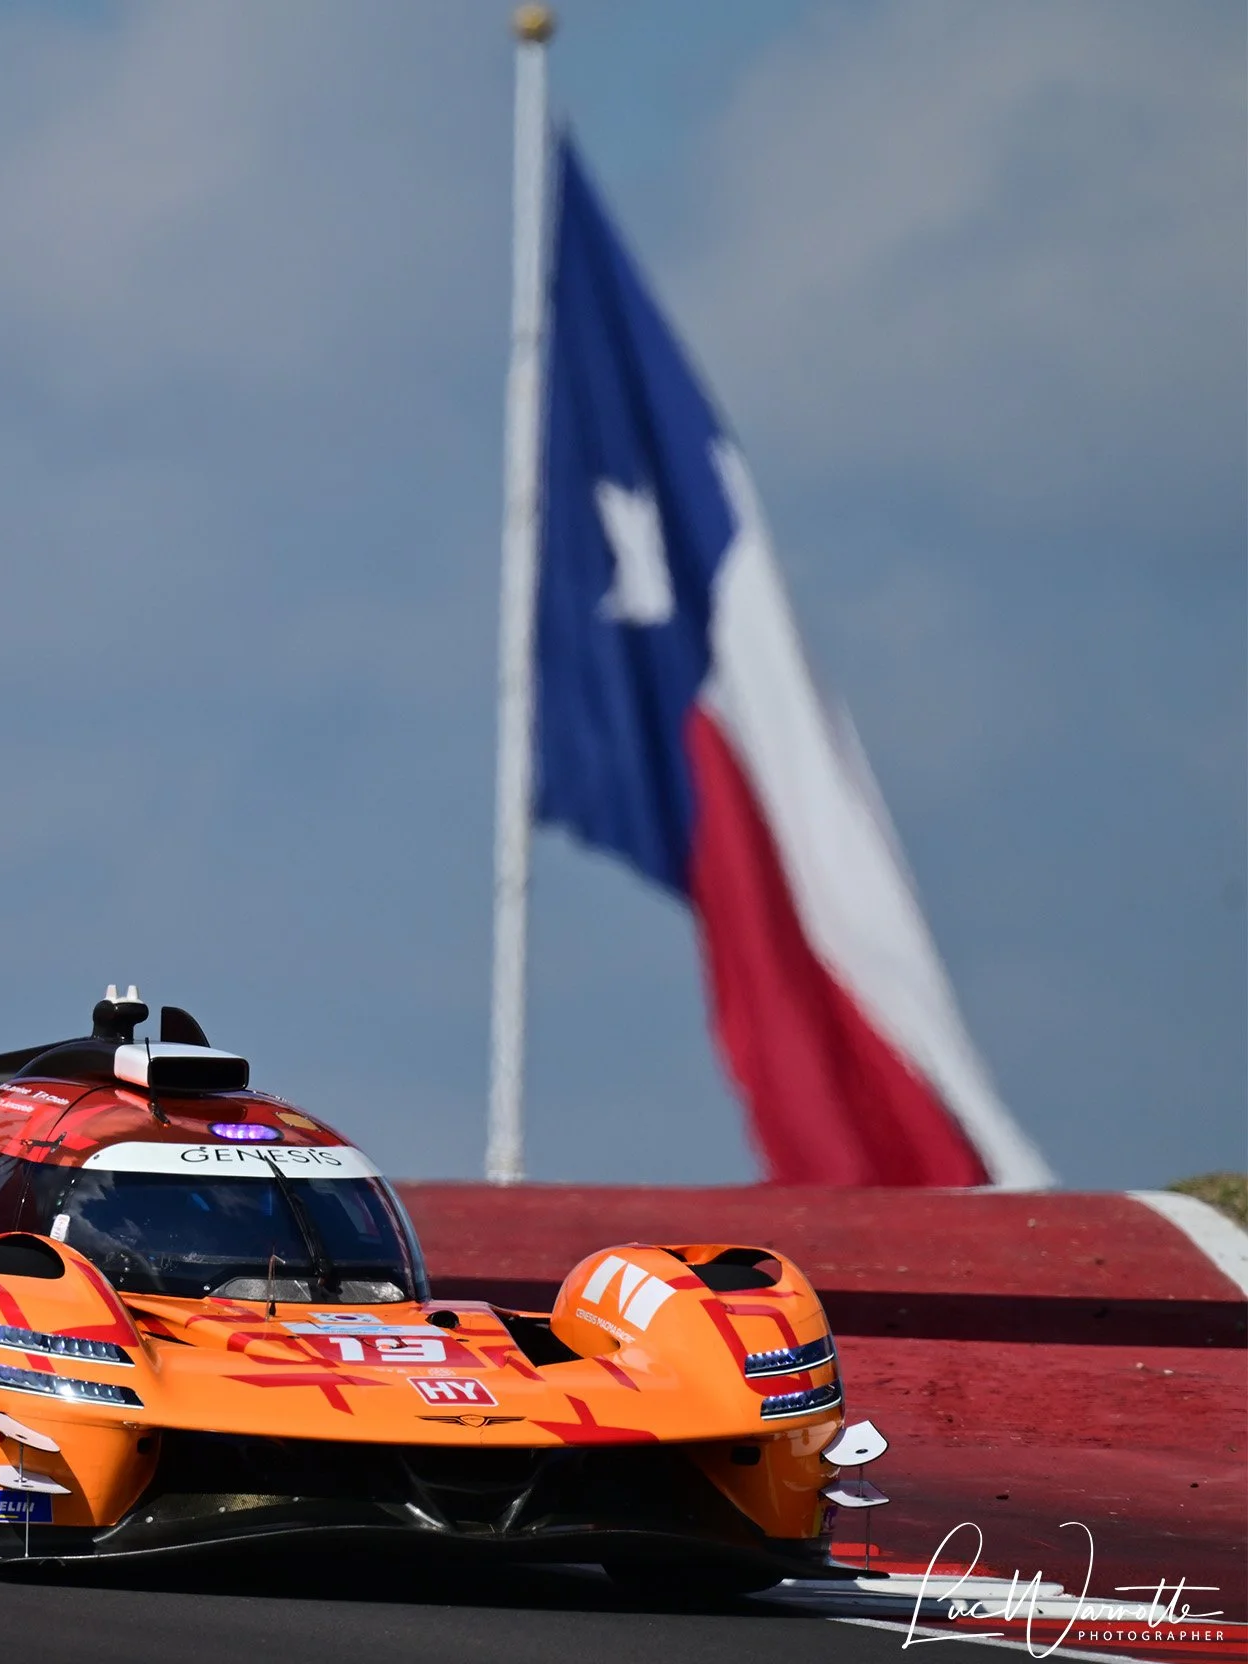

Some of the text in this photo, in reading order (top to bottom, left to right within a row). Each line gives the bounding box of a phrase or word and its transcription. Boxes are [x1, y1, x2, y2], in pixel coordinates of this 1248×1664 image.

[181, 1147, 342, 1166] GENESIS
[329, 1336, 447, 1362] 19
[417, 1381, 479, 1400] HY
